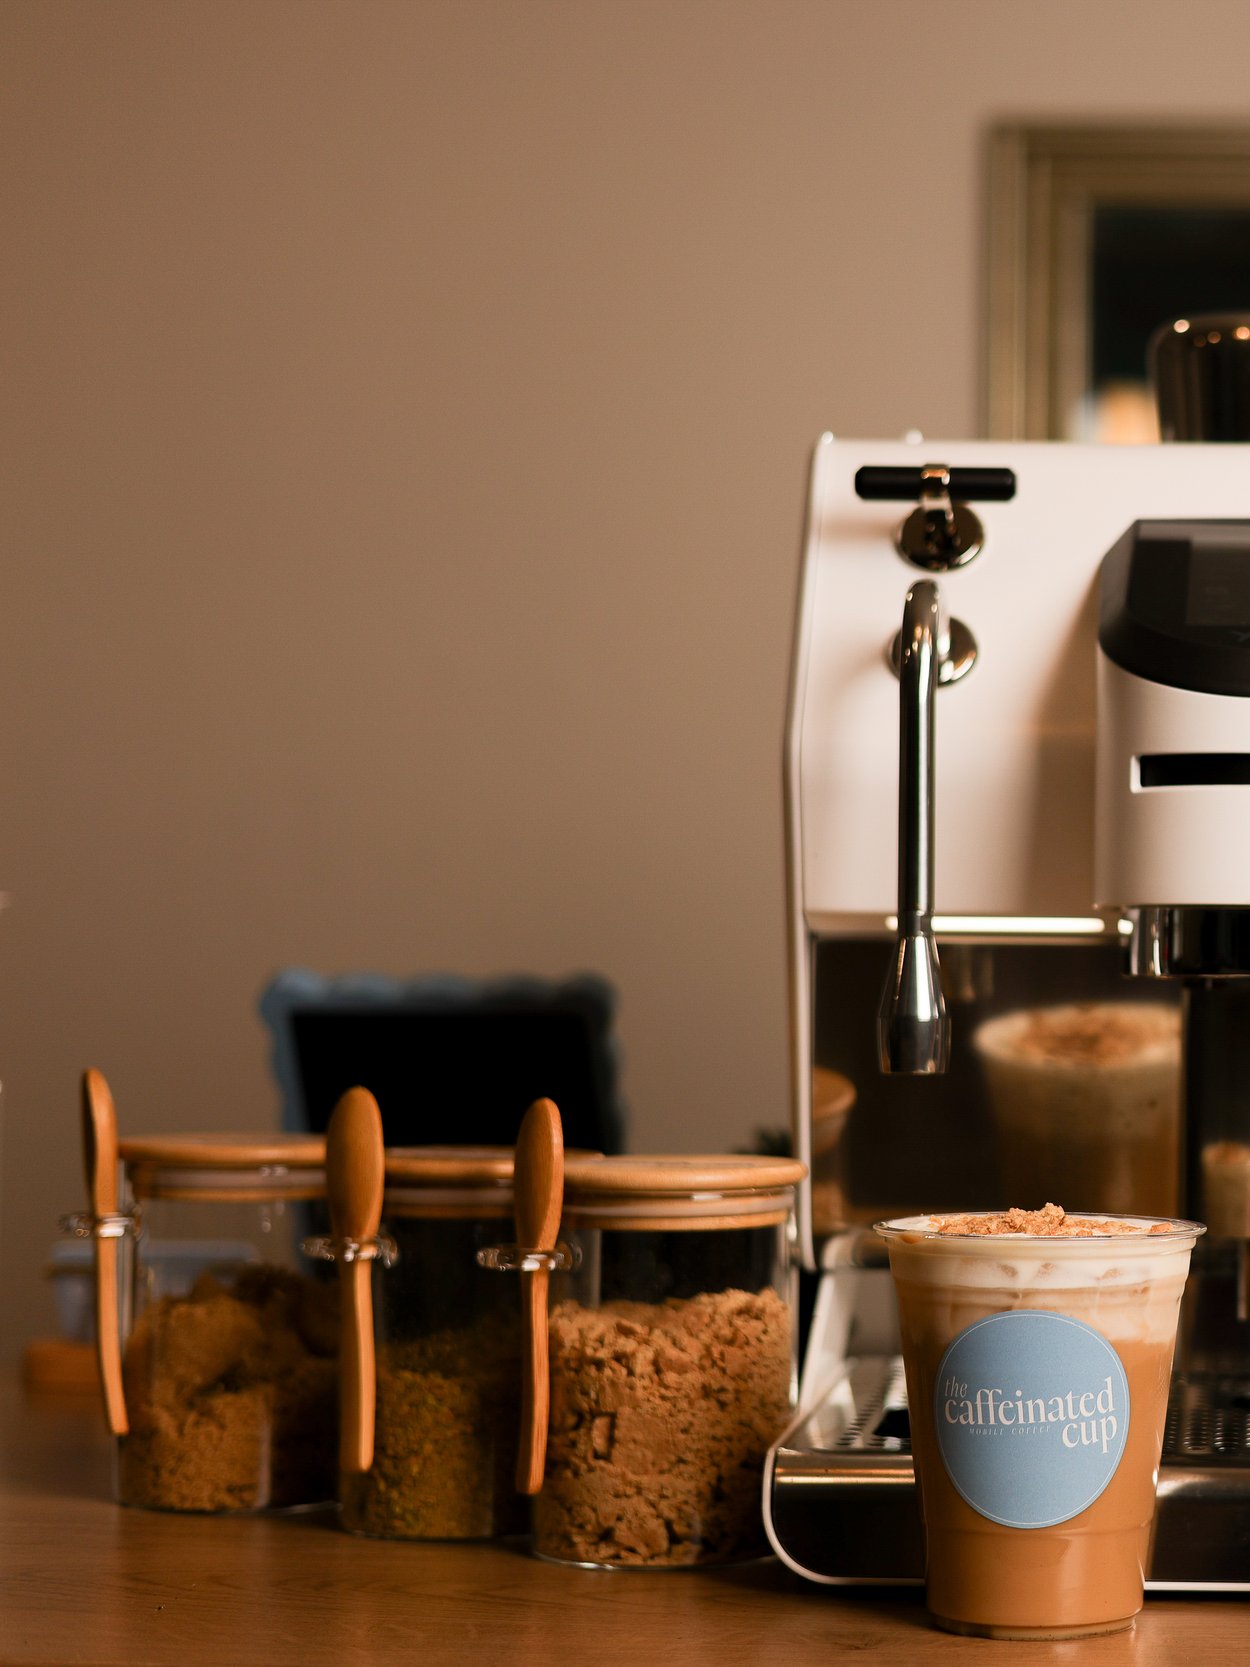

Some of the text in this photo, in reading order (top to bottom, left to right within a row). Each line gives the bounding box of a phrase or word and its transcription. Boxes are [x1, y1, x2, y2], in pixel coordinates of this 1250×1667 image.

[944, 1376, 968, 1399] the
[944, 1376, 1116, 1427] caffeinated
[1062, 1414, 1118, 1454] cup
